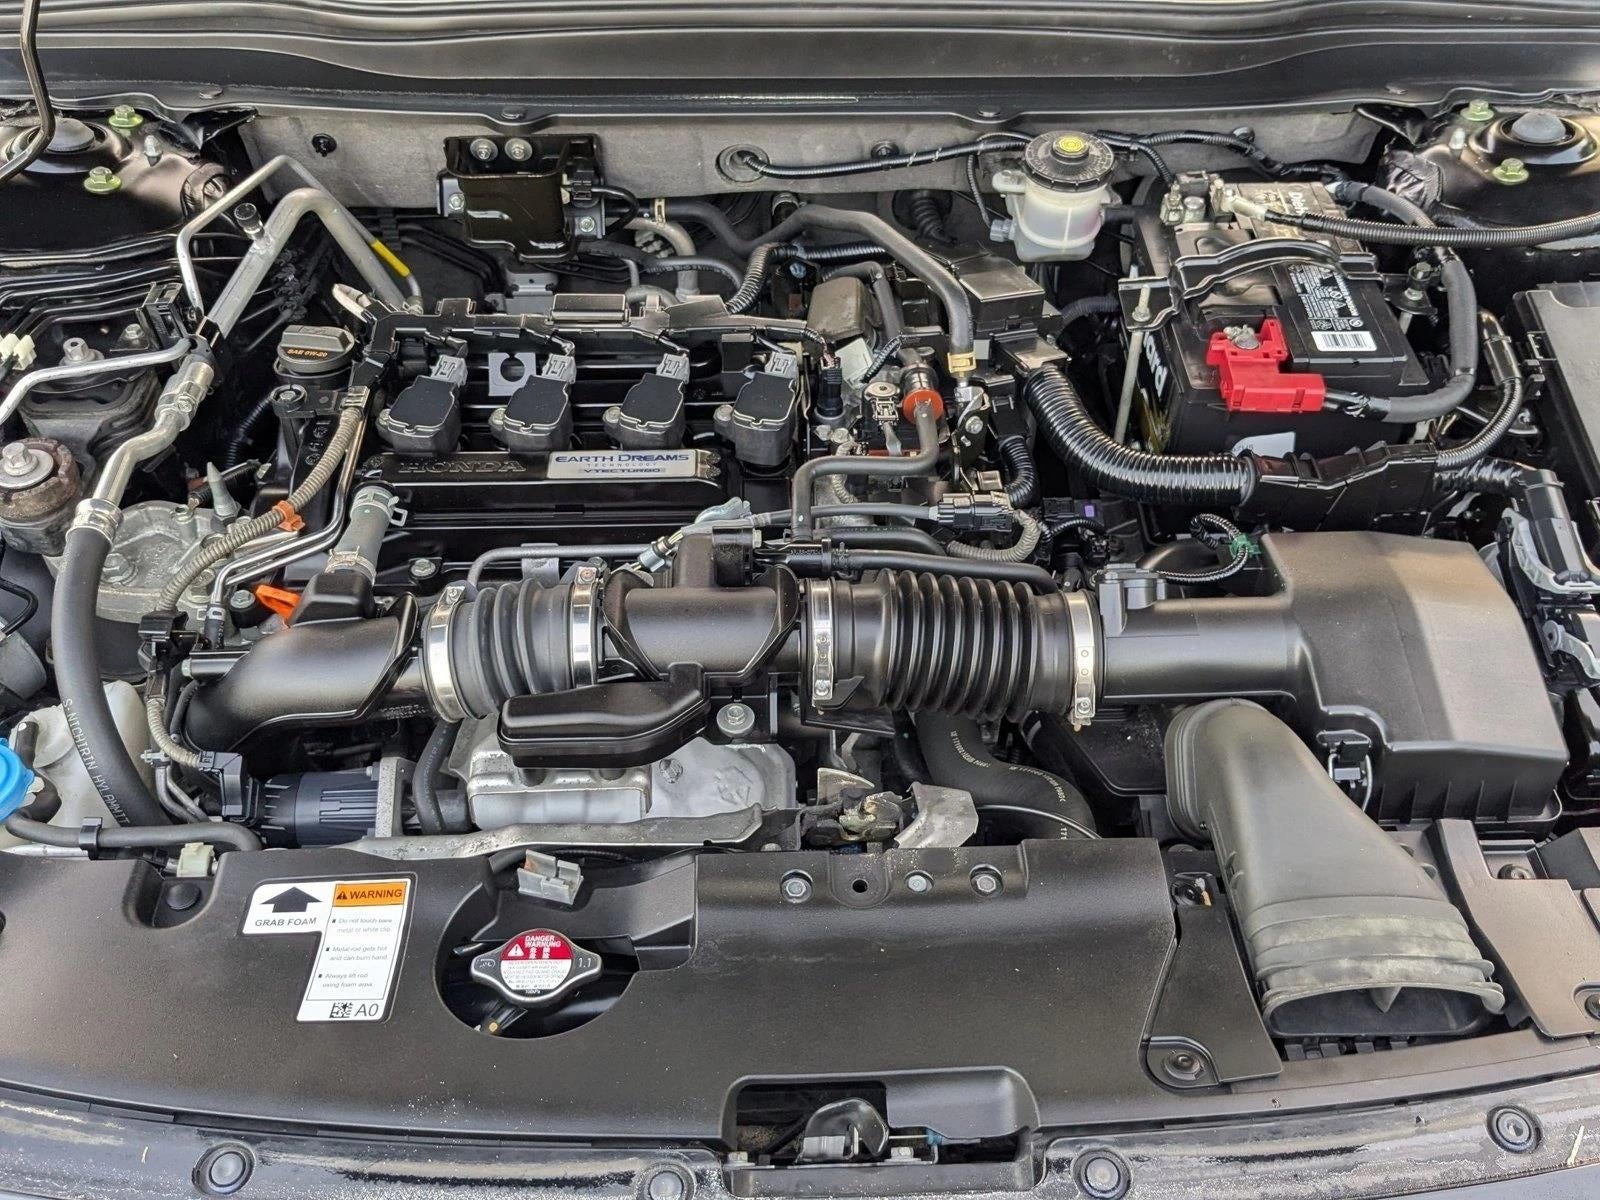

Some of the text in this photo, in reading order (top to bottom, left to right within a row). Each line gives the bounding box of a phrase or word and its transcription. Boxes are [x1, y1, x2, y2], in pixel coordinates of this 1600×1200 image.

[555, 454, 689, 463] EARTH DREAMS
[398, 460, 526, 473] HONDA
[350, 889, 402, 900] WARNING
[287, 917, 317, 926] FOAM
[578, 957, 592, 968] 1.1
[354, 1003, 379, 1017] A0
